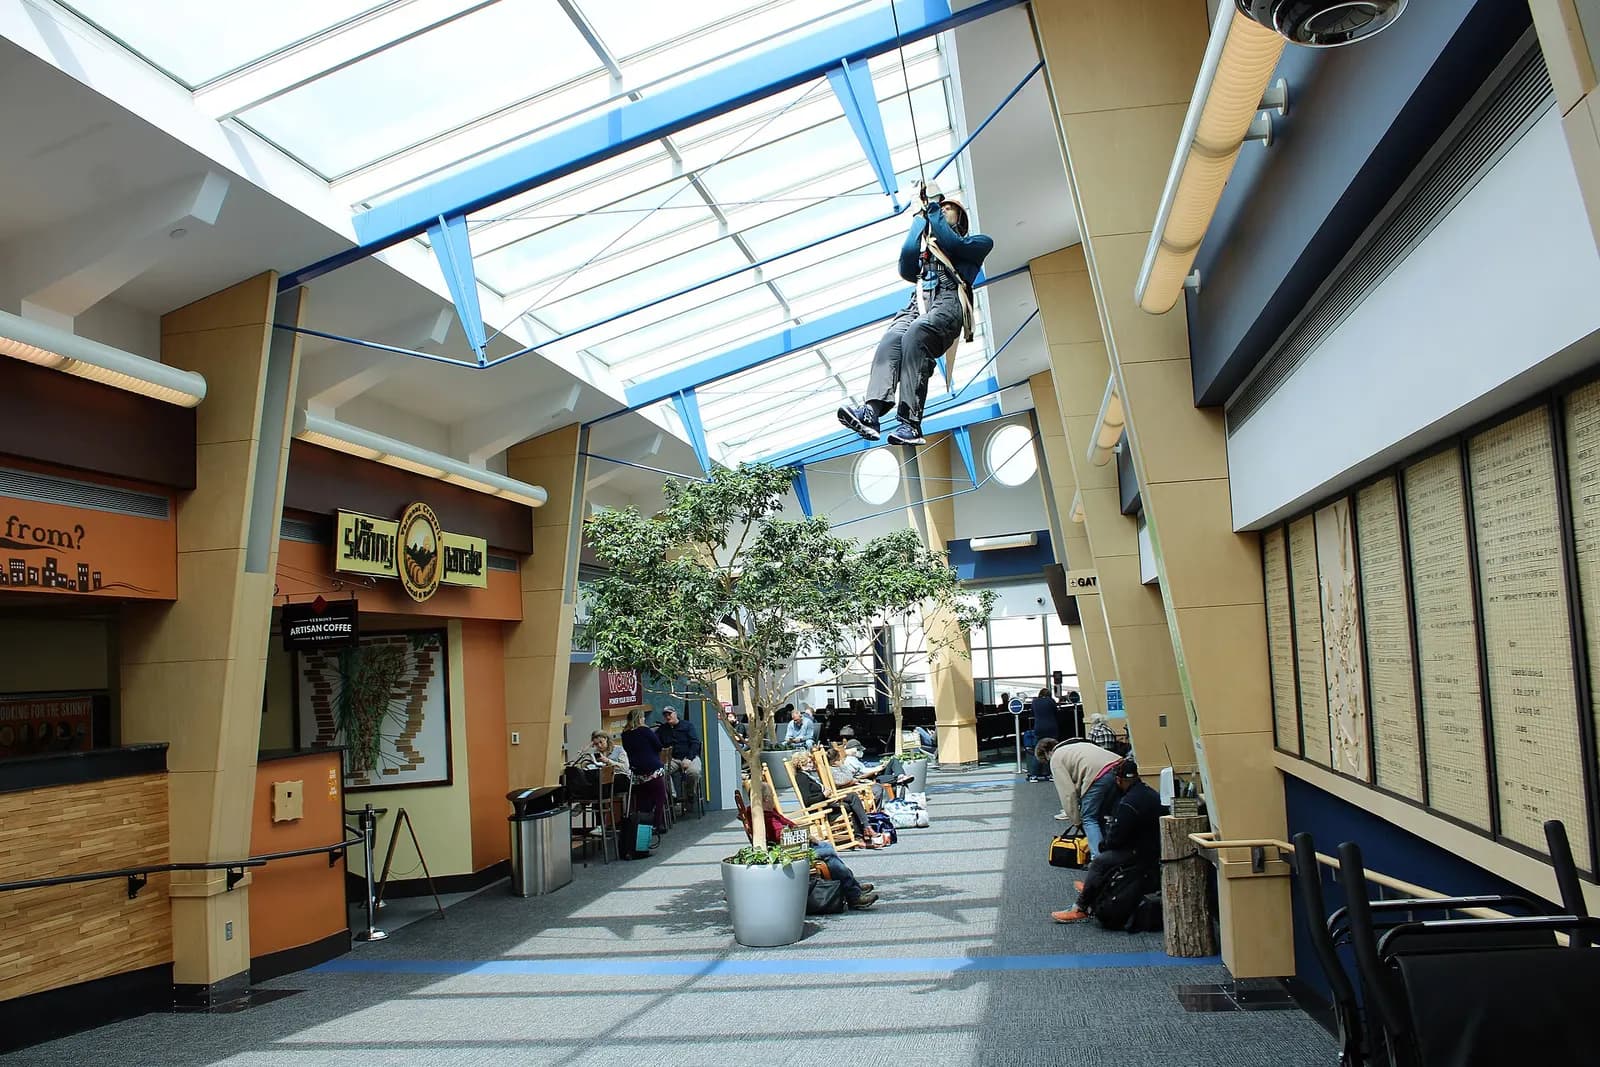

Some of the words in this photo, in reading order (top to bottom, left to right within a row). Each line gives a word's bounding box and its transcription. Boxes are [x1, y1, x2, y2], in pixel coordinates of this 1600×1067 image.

[5, 515, 85, 550] from?
[290, 624, 322, 636] ARTISAN
[323, 623, 352, 632] COFFEE
[31, 703, 46, 719] FOR
[48, 702, 60, 717] THE
[783, 833, 807, 845] TREES!
